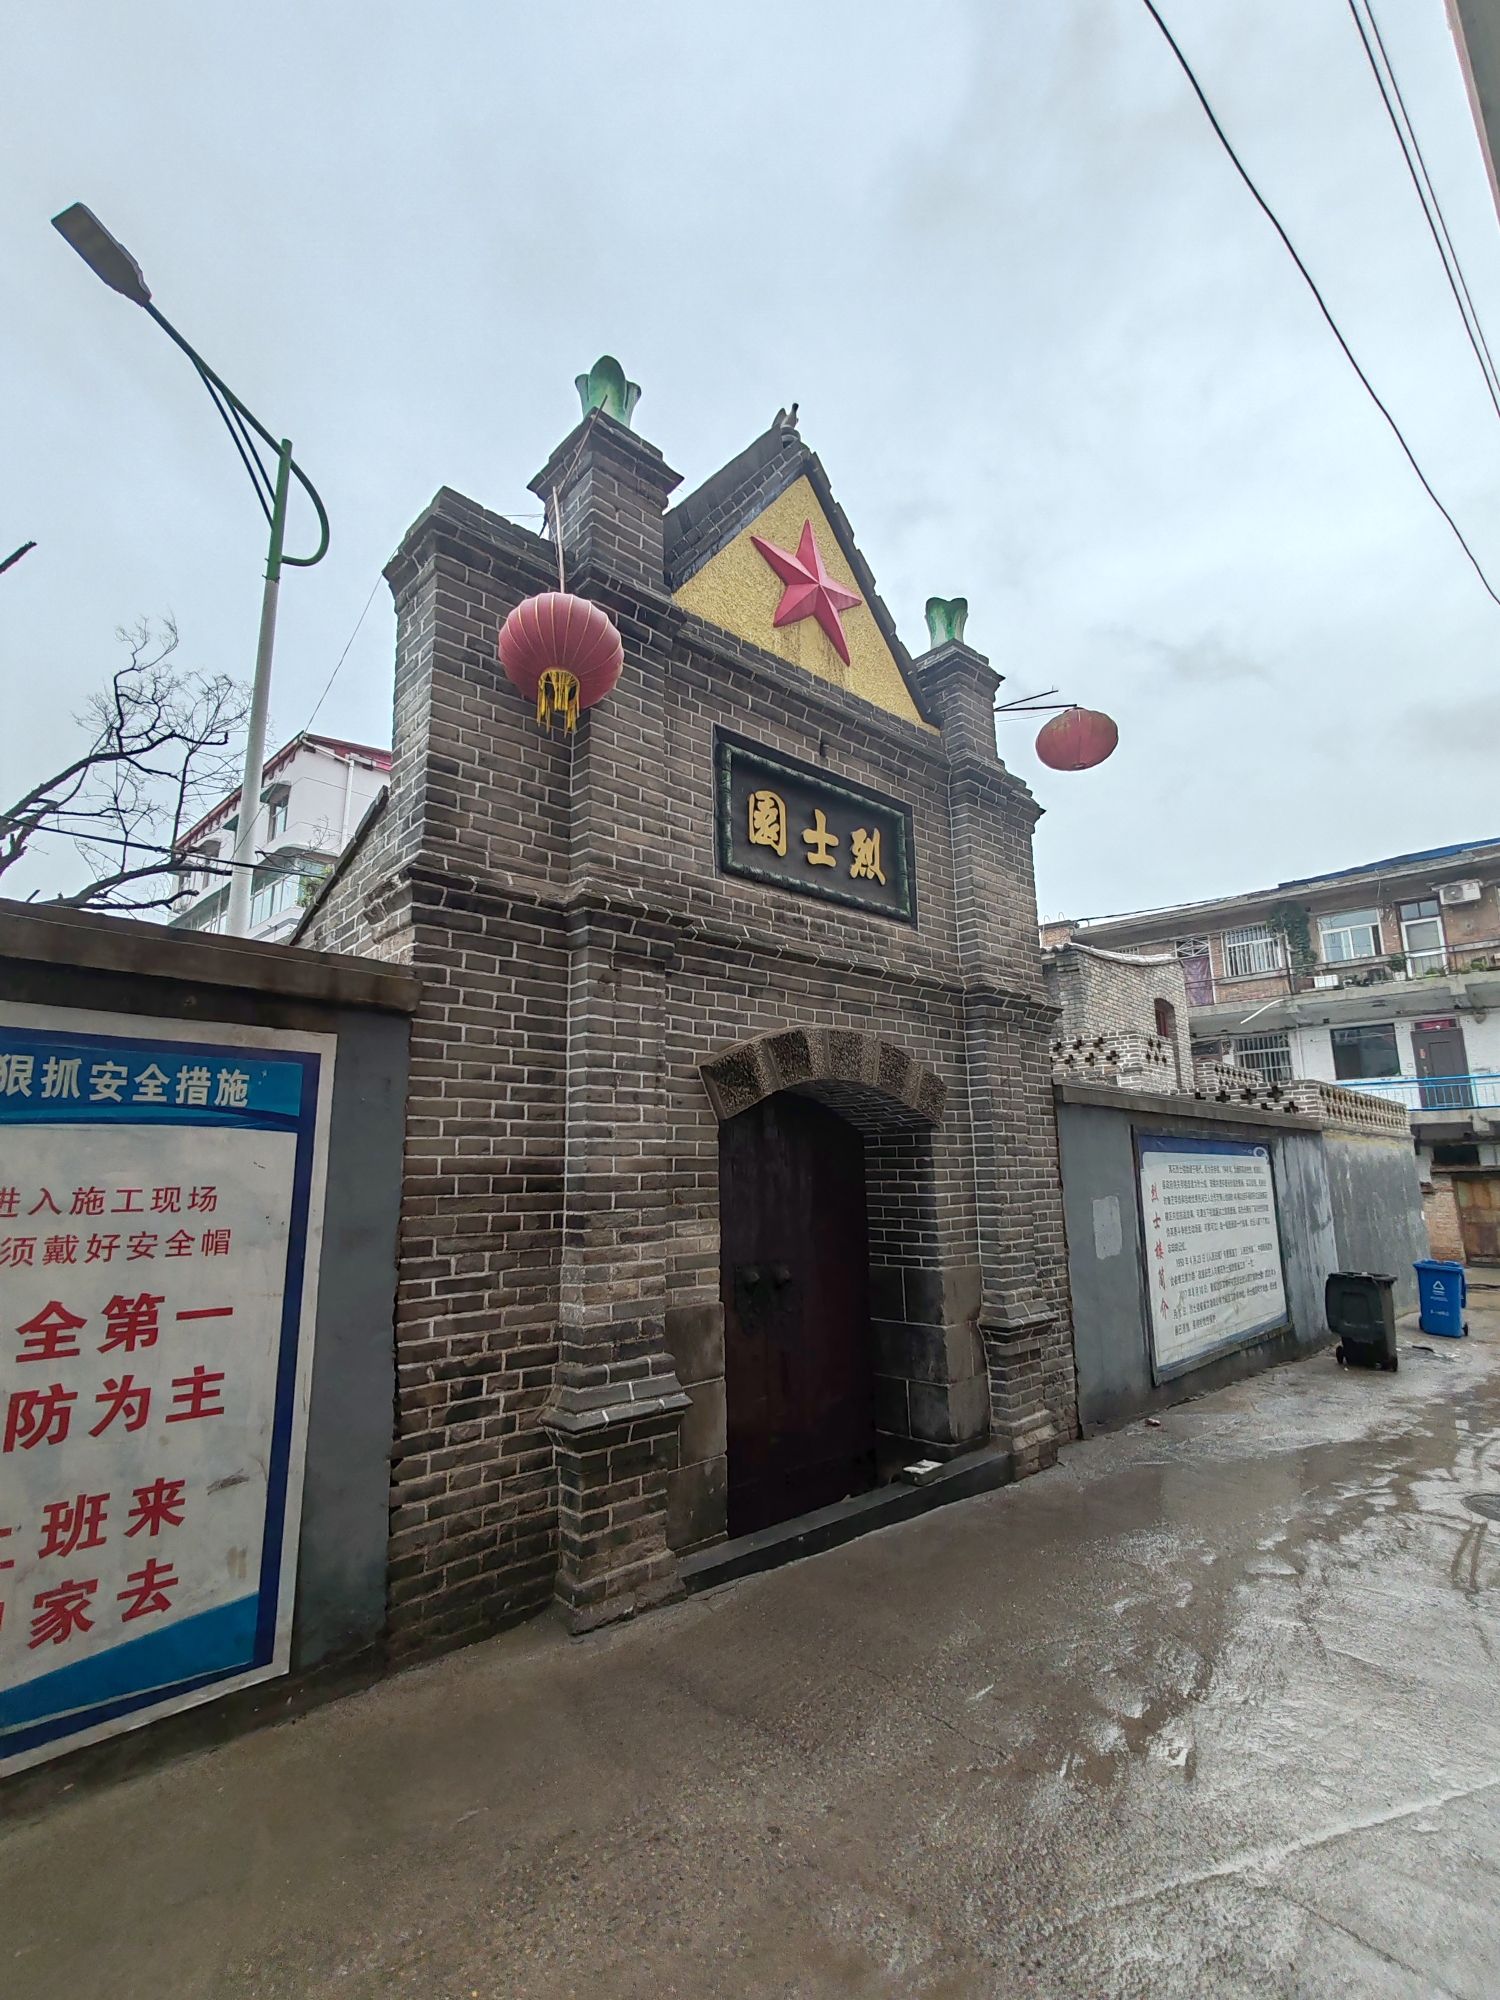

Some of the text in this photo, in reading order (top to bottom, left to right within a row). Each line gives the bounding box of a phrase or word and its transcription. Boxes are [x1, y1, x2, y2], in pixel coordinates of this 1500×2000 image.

[0, 1054, 250, 1108] 狠抓安全措施
[0, 1228, 232, 1268] 须戴好安全帽
[15, 1292, 234, 1363] 全第一
[3, 1365, 225, 1453] 防为主
[0, 1477, 186, 1572] 班来
[0, 1558, 179, 1649] 家去
